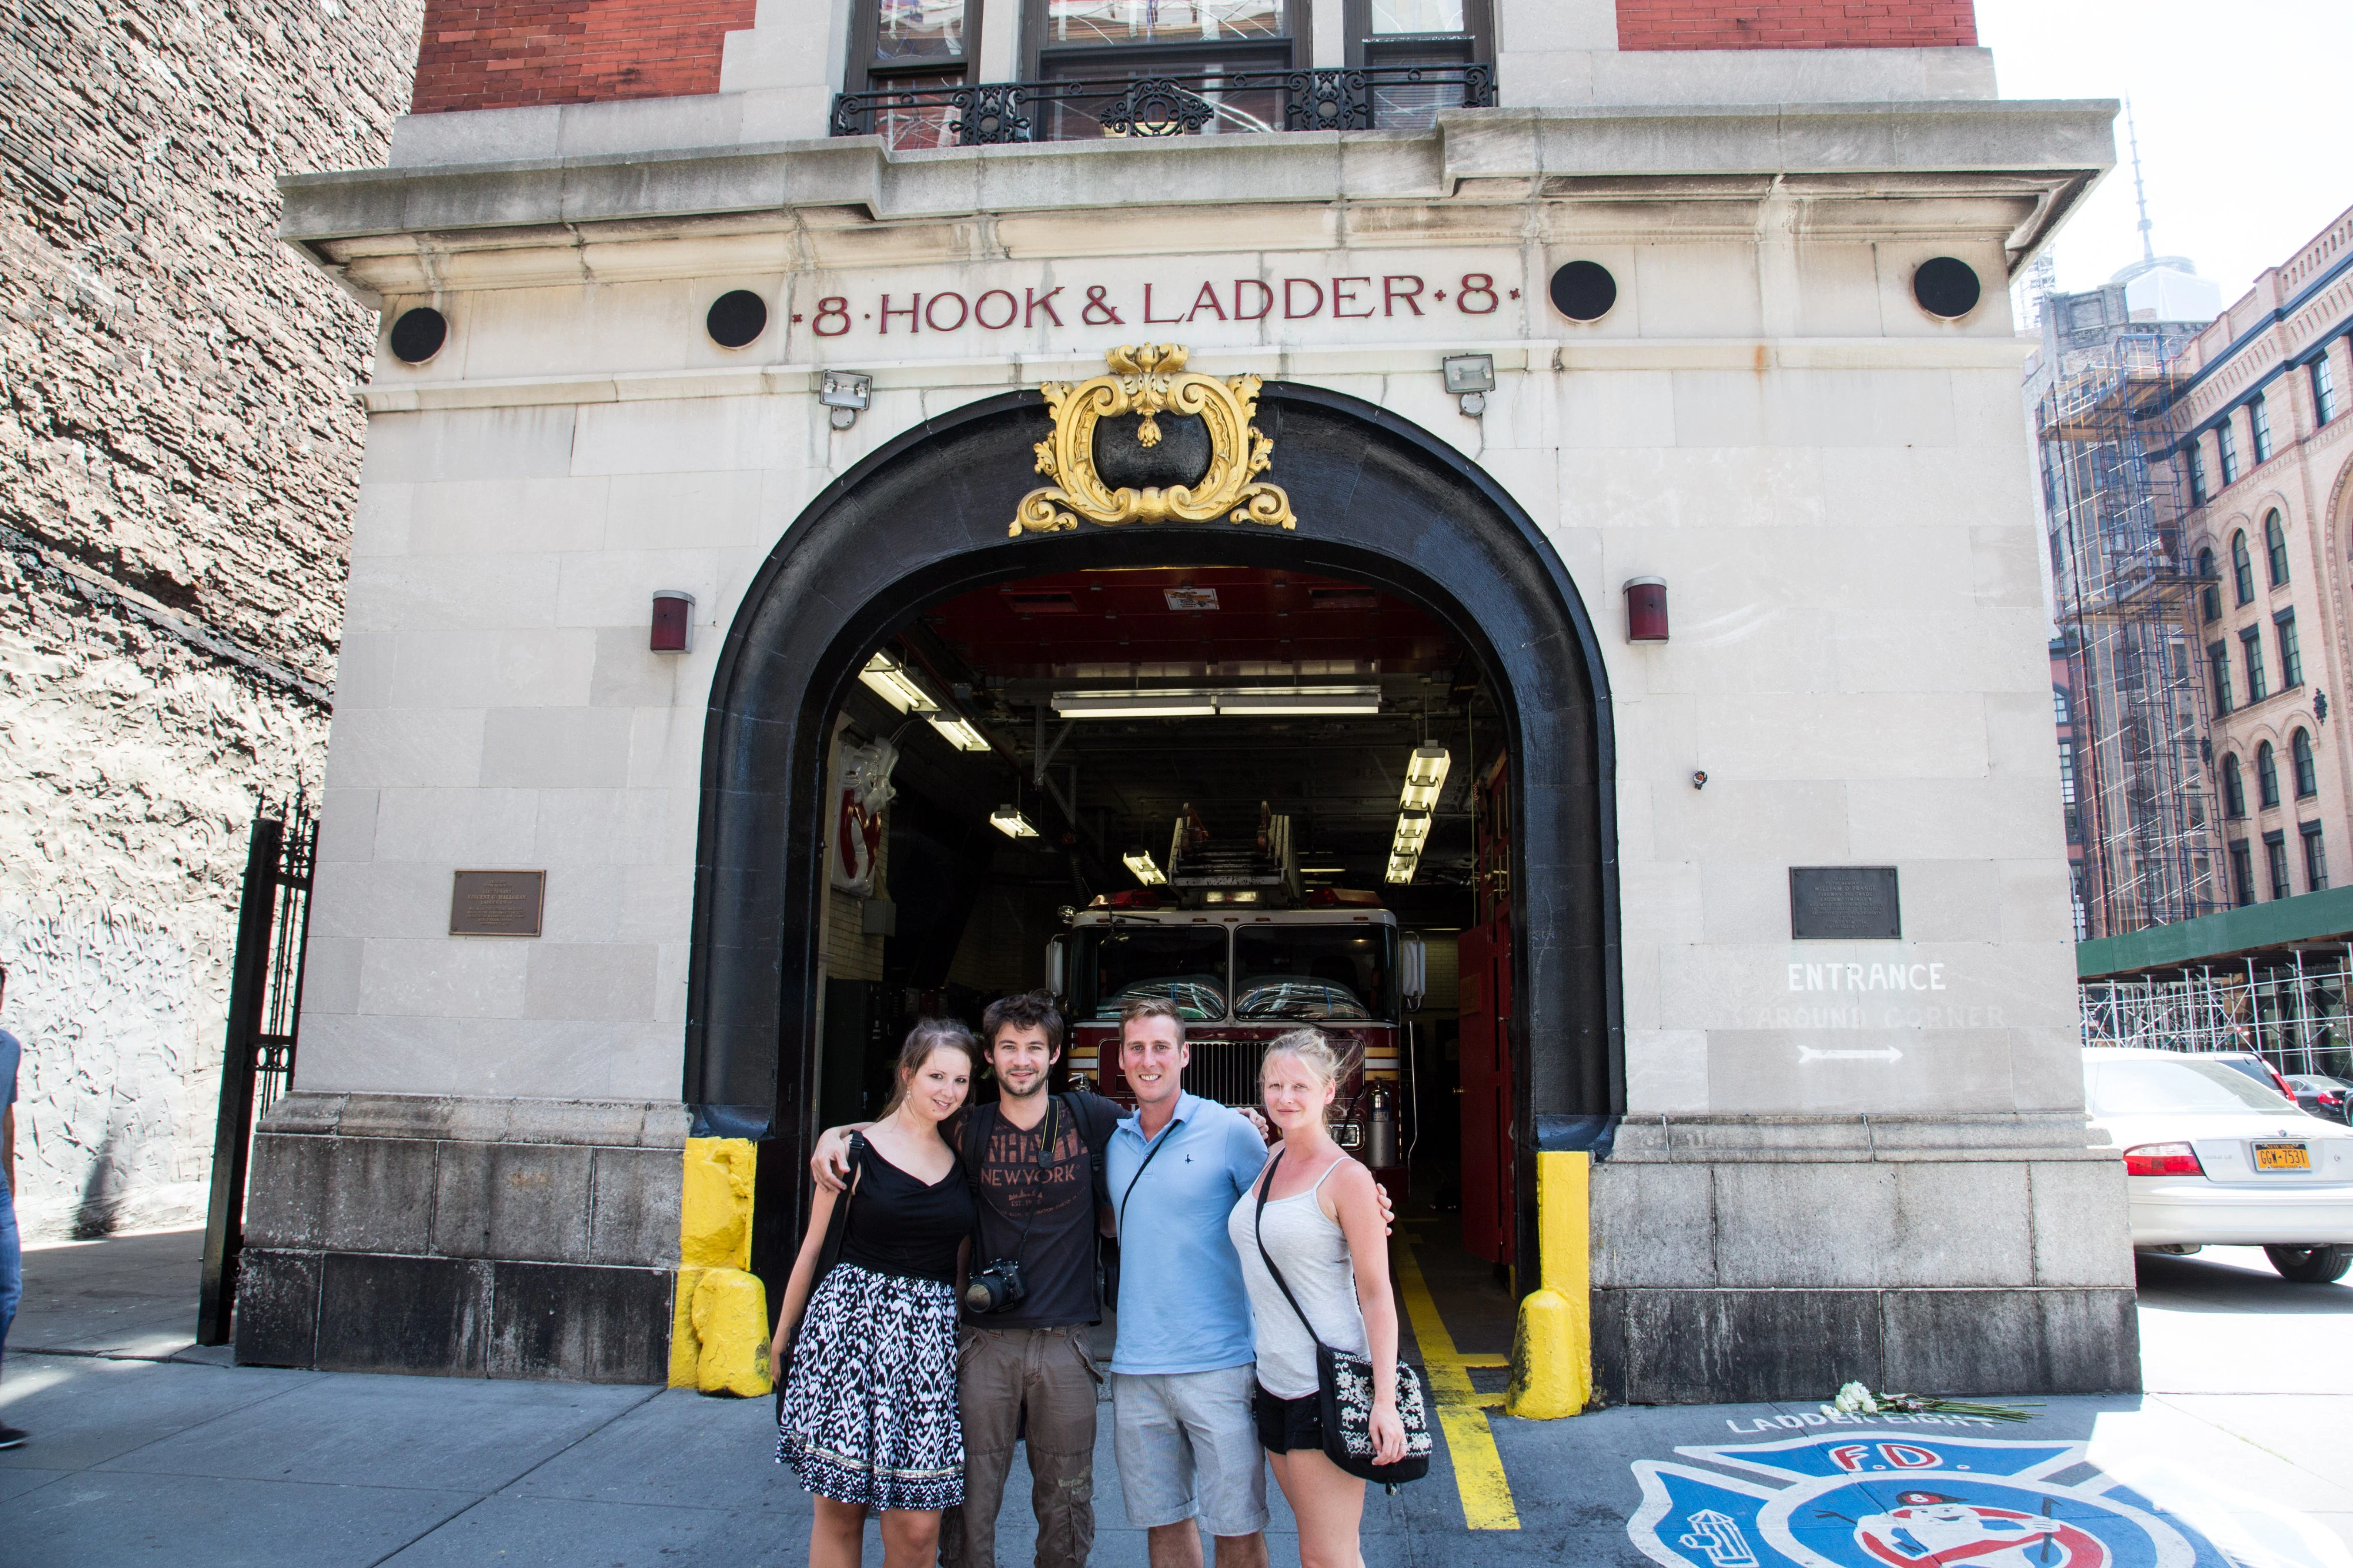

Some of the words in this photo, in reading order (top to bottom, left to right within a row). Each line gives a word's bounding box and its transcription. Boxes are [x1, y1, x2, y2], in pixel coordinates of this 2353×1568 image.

[812, 296, 851, 337] 8
[878, 286, 1066, 334] HOOK
[1081, 285, 1127, 326] &
[1143, 275, 1425, 324] LADDER
[1456, 273, 1499, 314] 8
[1788, 962, 1946, 991] ENTRANCE
[1756, 1005, 1866, 1029] AROUND
[1884, 1005, 2007, 1028] CORNER
[1908, 1493, 1929, 1503] 8
